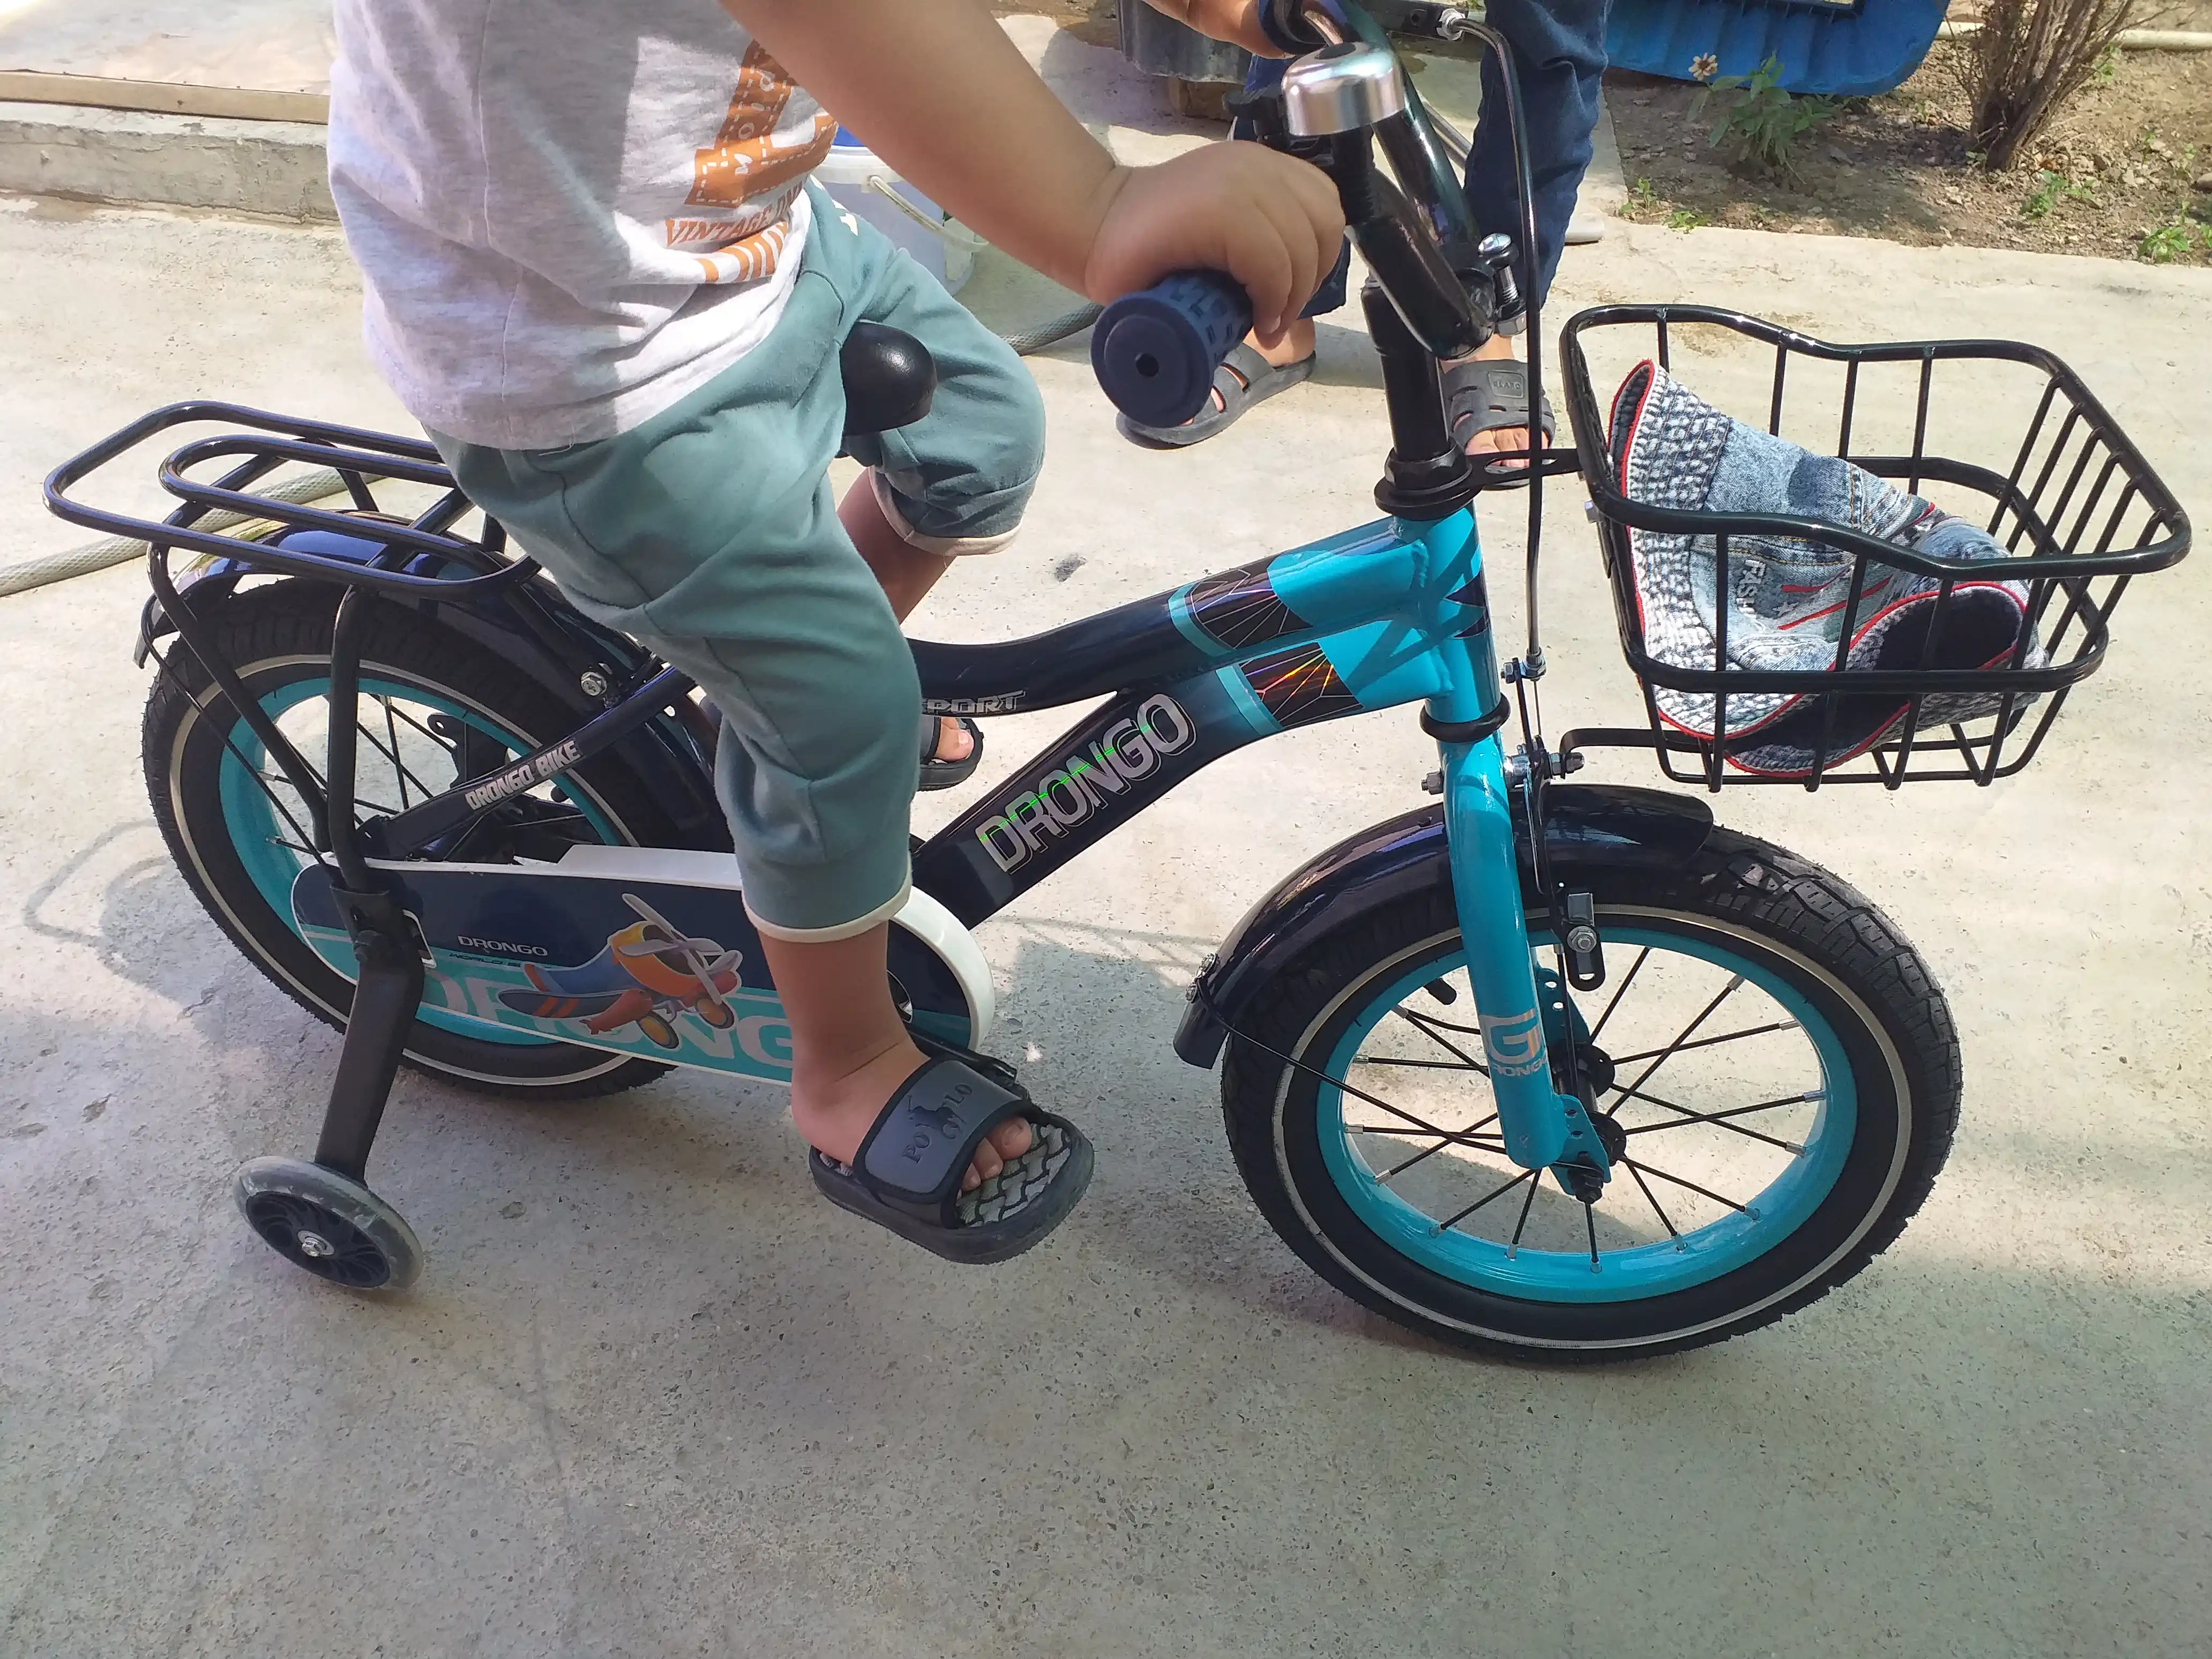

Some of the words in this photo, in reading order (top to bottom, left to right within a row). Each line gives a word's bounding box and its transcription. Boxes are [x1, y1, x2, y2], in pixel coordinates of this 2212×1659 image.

[921, 689, 1026, 714] PORT
[465, 765, 535, 811] DRONGO
[535, 740, 581, 777] BIKE
[974, 693, 1197, 875] DRONGO
[457, 936, 548, 956] DRONGO
